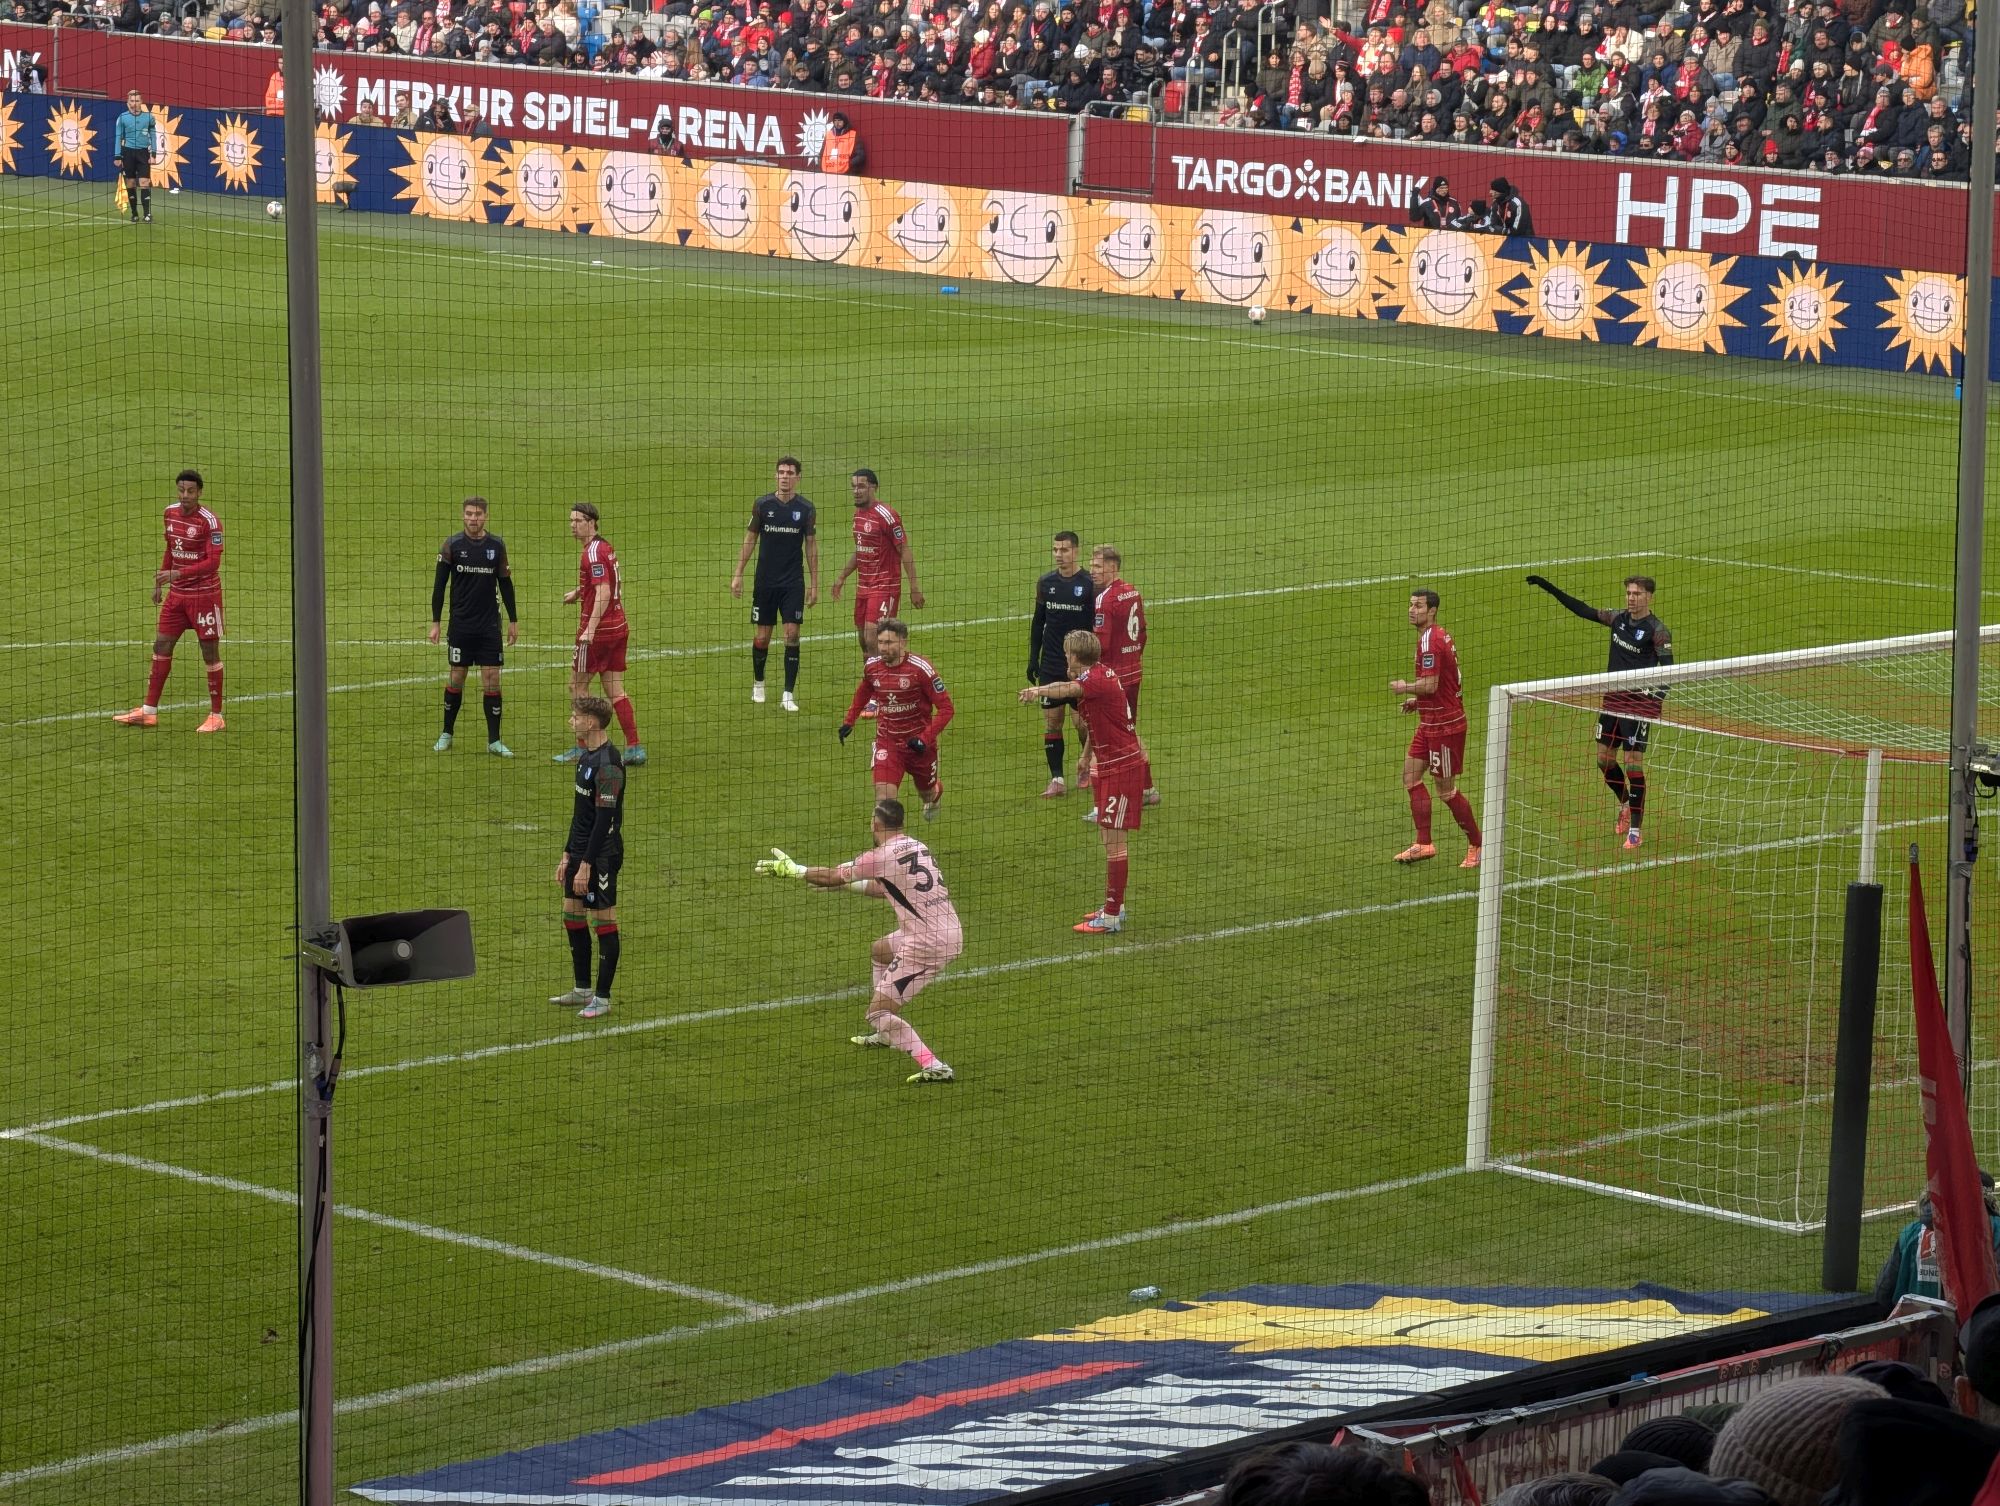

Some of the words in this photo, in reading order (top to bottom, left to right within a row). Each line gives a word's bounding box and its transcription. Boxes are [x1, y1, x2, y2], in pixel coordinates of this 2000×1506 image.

[356, 77, 514, 127] MERKUR
[522, 91, 786, 155] SPIEL-ARENA
[1615, 172, 1821, 260] HPE
[197, 611, 215, 627] 46
[879, 601, 888, 616] 4
[1127, 601, 1139, 641] 6
[1429, 750, 1441, 767] 15
